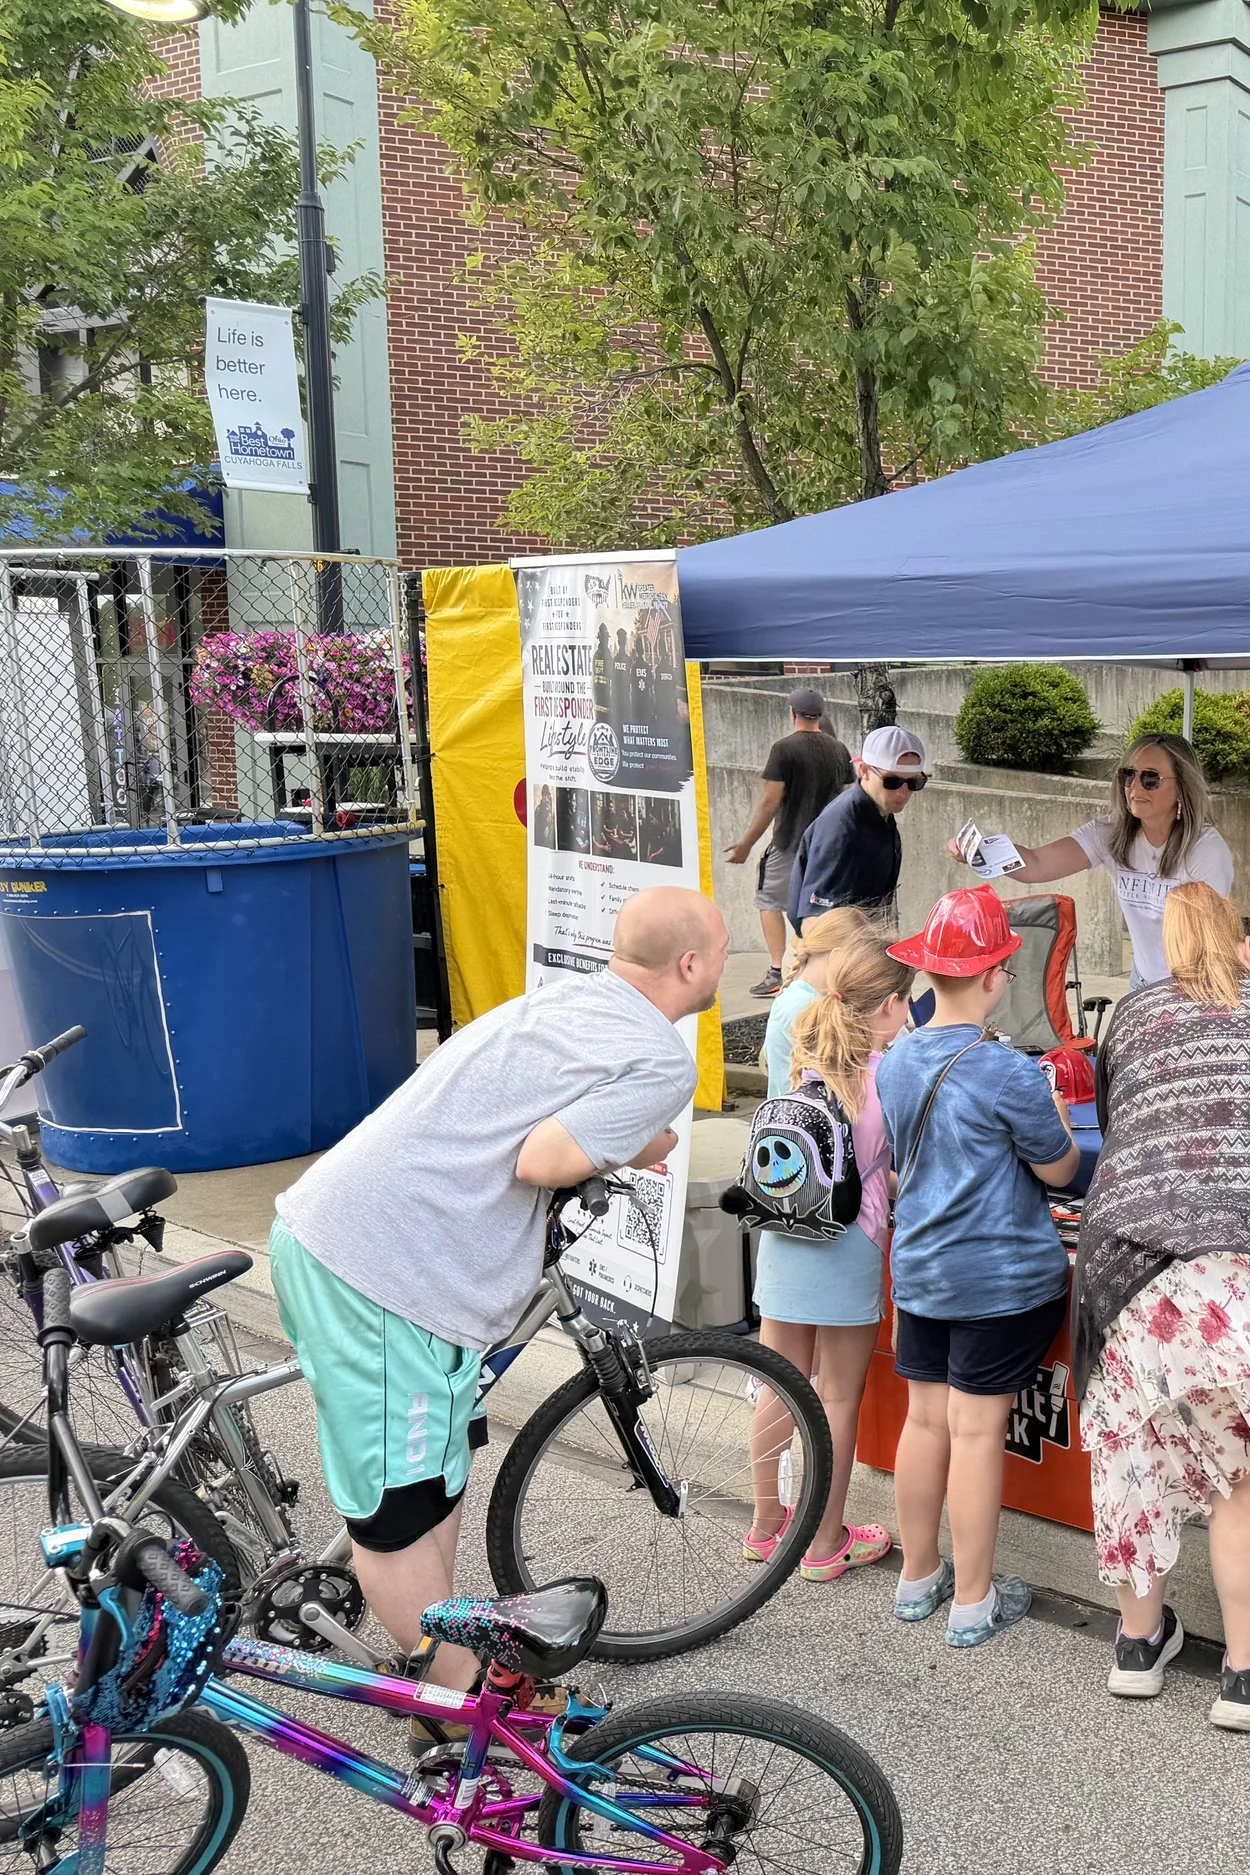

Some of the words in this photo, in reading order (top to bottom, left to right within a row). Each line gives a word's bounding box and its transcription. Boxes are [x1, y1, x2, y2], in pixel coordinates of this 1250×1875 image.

[217, 327, 246, 345] Life
[251, 331, 263, 347] is
[217, 355, 265, 375] better
[218, 384, 262, 402] here.
[241, 434, 265, 447] Best
[231, 443, 294, 458] Hometown
[224, 456, 276, 467] CUYAHOGA
[277, 460, 302, 470] FALLS
[532, 645, 554, 675] REAL
[557, 645, 592, 676] ESTATE
[539, 1857, 616, 1869] KENT
